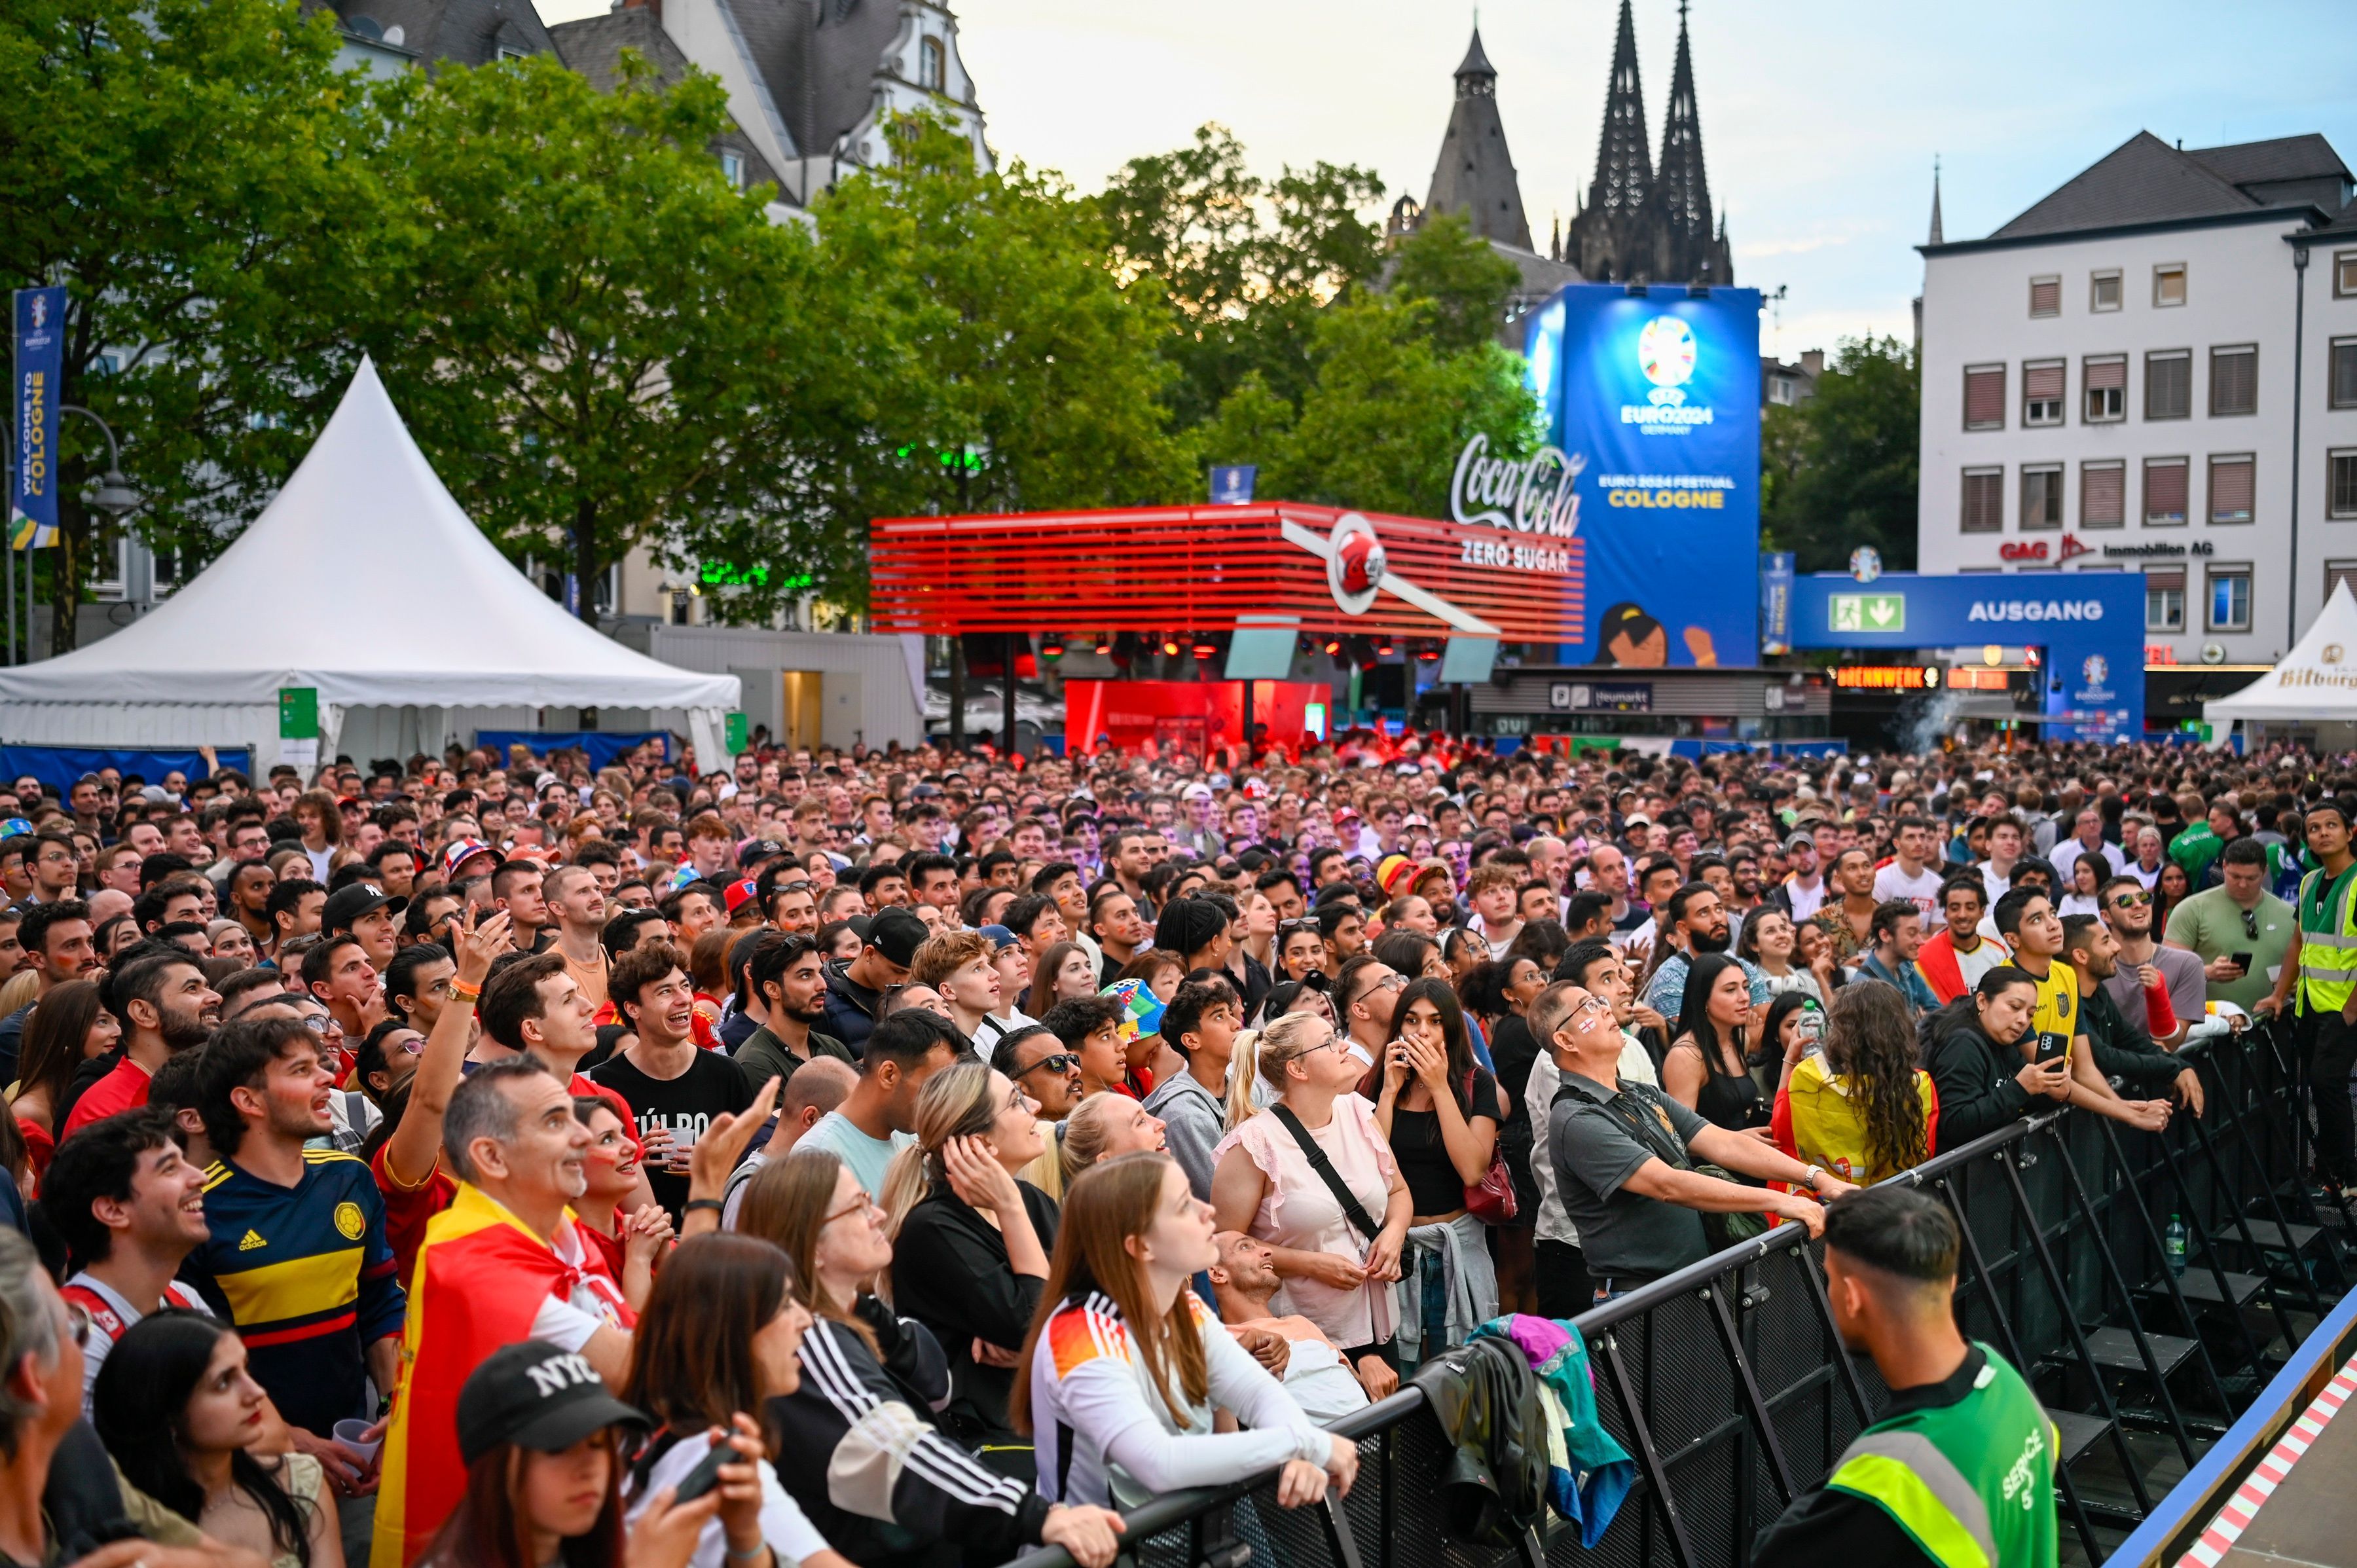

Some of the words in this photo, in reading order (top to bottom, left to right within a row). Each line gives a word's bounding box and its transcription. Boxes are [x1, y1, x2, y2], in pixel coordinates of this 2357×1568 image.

[24, 371, 32, 398] TO
[1620, 405, 1714, 425] EURO2024
[31, 371, 46, 496] COLOGNE
[23, 401, 31, 496] WELCOME
[1451, 431, 1589, 538] Coca-Cola
[1598, 474, 1636, 488] EURO
[1637, 474, 1673, 488] 2024
[1673, 475, 1736, 489] FESTIVAL
[1608, 489, 1725, 509] COLOGNE
[1461, 539, 1510, 568] ZERO
[1512, 543, 1571, 573] SUGAR
[2000, 540, 2049, 560] GAG
[2104, 543, 2185, 558] Immobilien
[2190, 540, 2214, 557] AG
[1967, 600, 2104, 622] AUSGANG
[1596, 690, 1648, 703] Heumarkt
[239, 1240, 267, 1251] adidas
[526, 1353, 601, 1397] NYC
